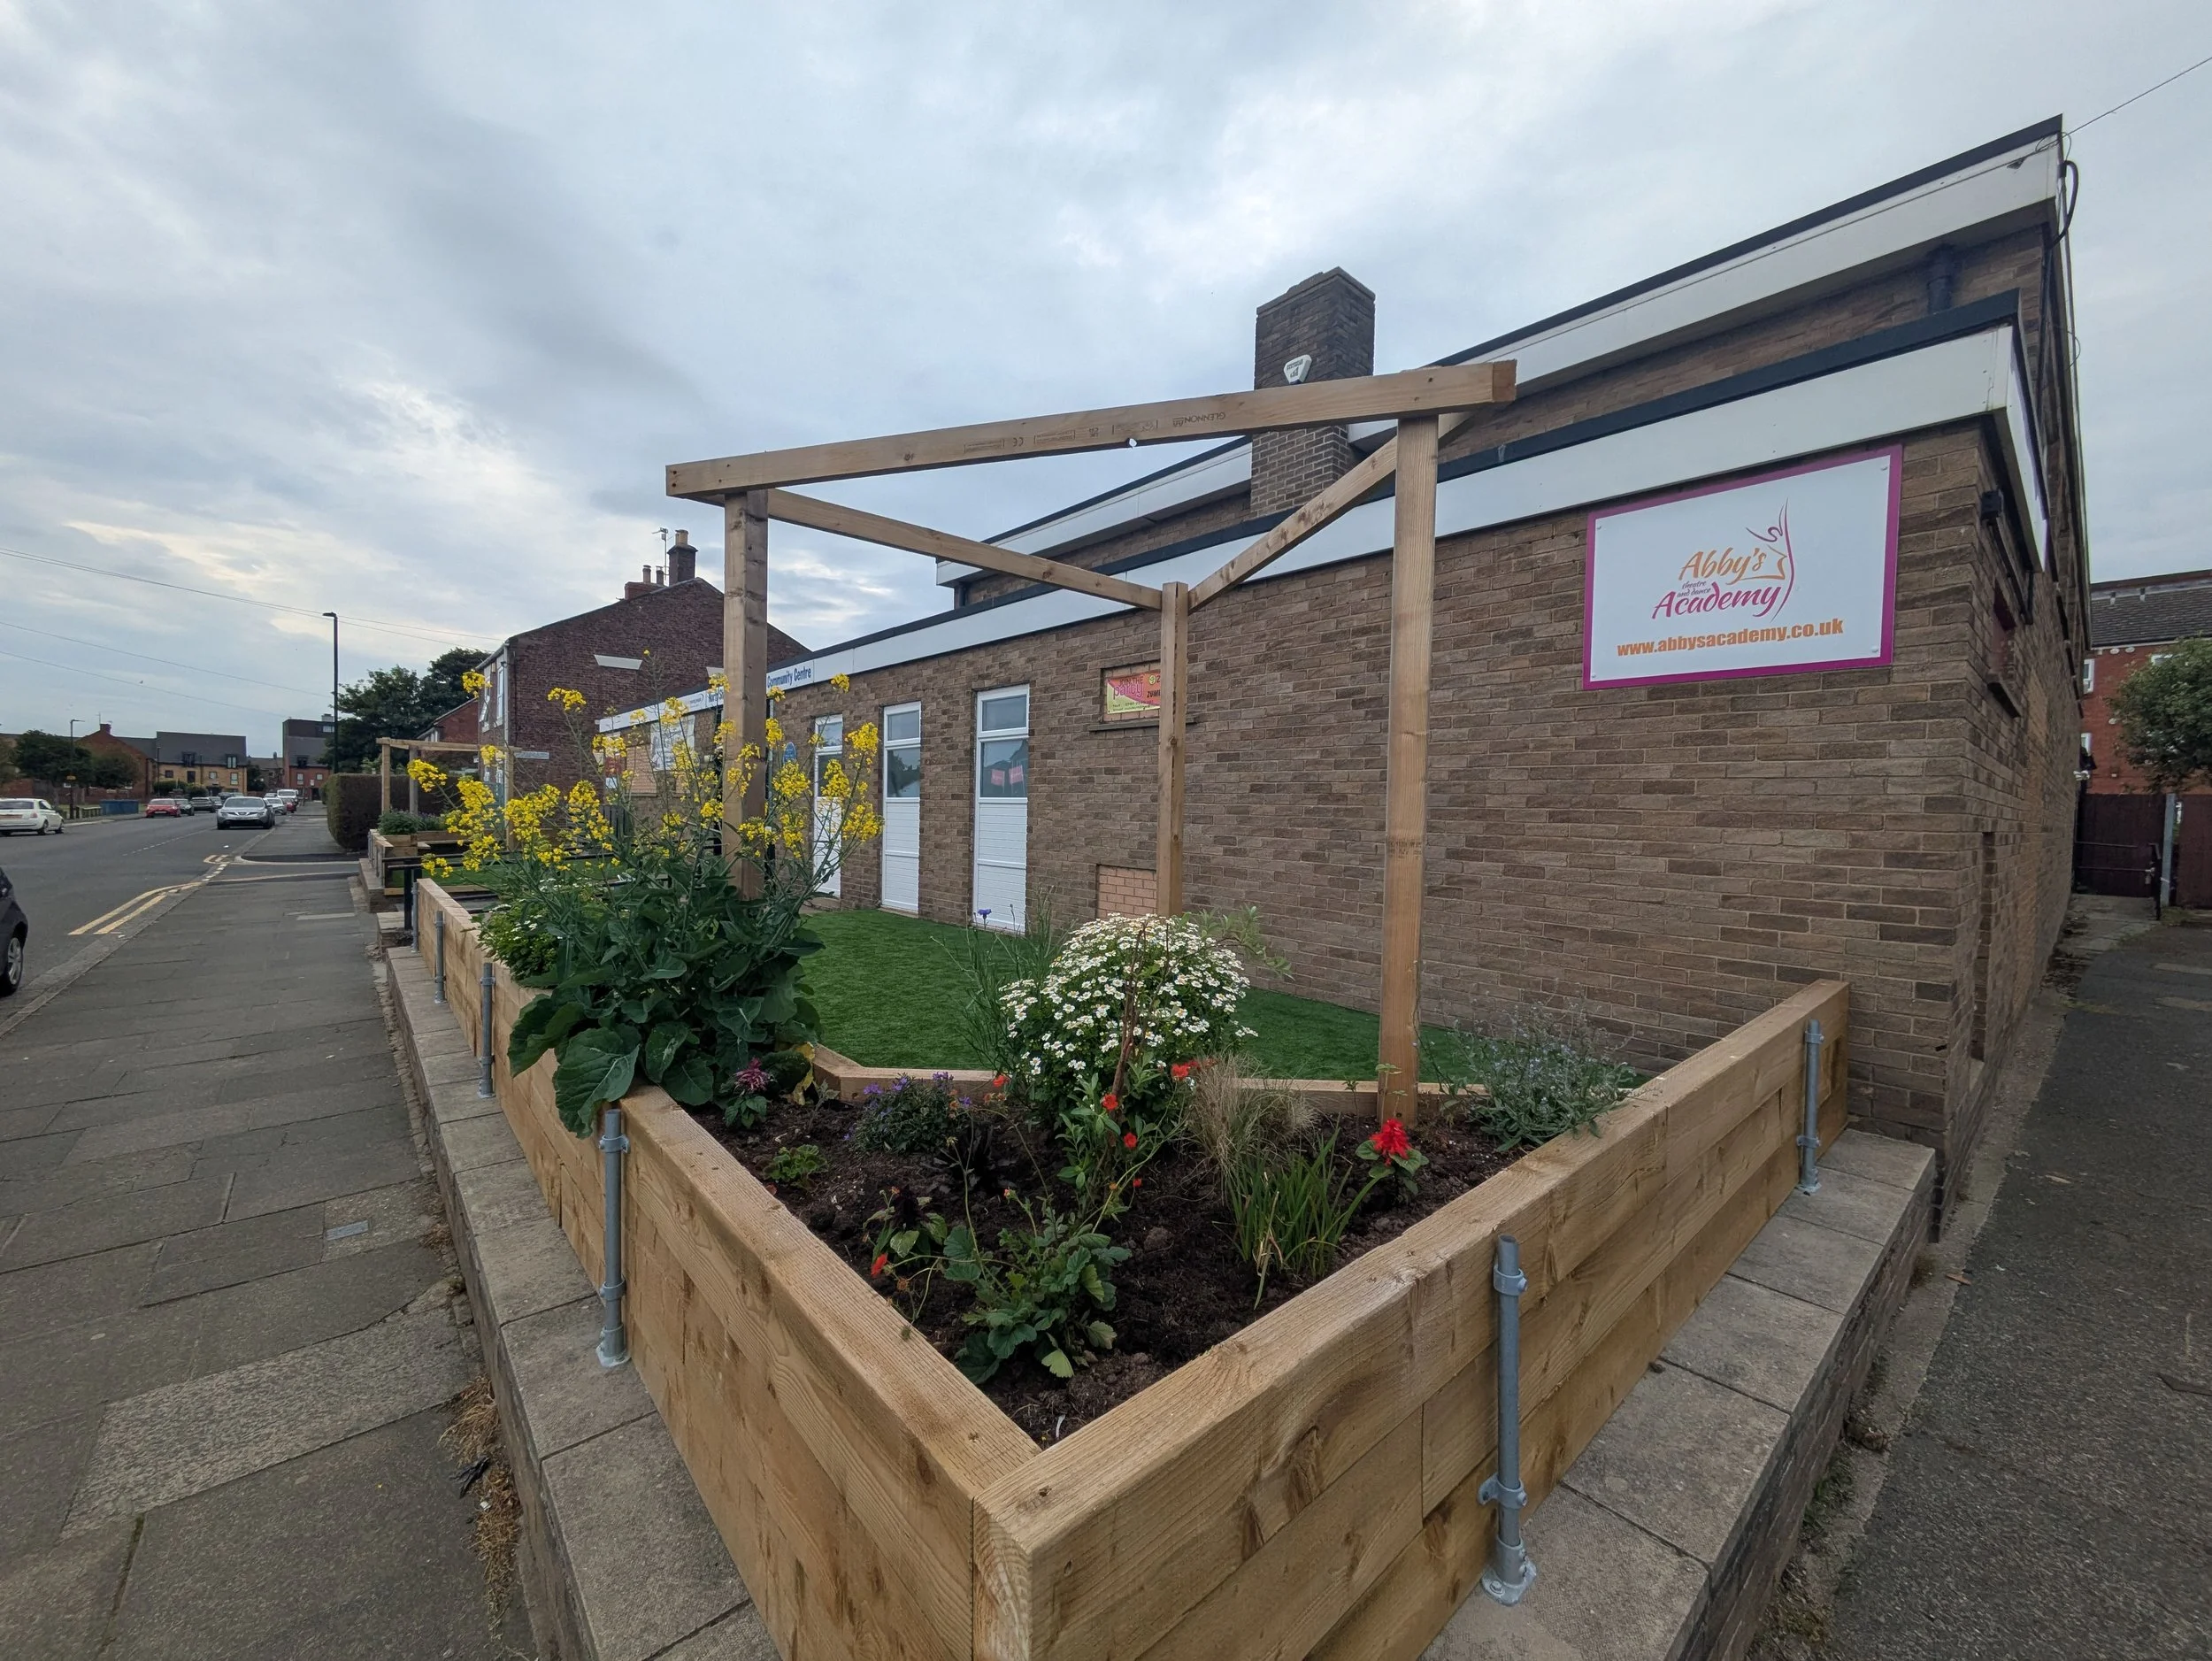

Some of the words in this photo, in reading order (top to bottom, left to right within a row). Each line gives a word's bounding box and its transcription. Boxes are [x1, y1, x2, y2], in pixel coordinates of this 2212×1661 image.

[1185, 411, 1225, 424] GLENNON
[1678, 547, 1767, 585] Abby's
[1677, 588, 1691, 597] and
[1682, 581, 1707, 589] theatre
[1651, 581, 1782, 619] Academy
[1617, 618, 1844, 657] www.abbysacademy.co.uk
[767, 670, 793, 688] Community
[794, 666, 812, 681] Centre
